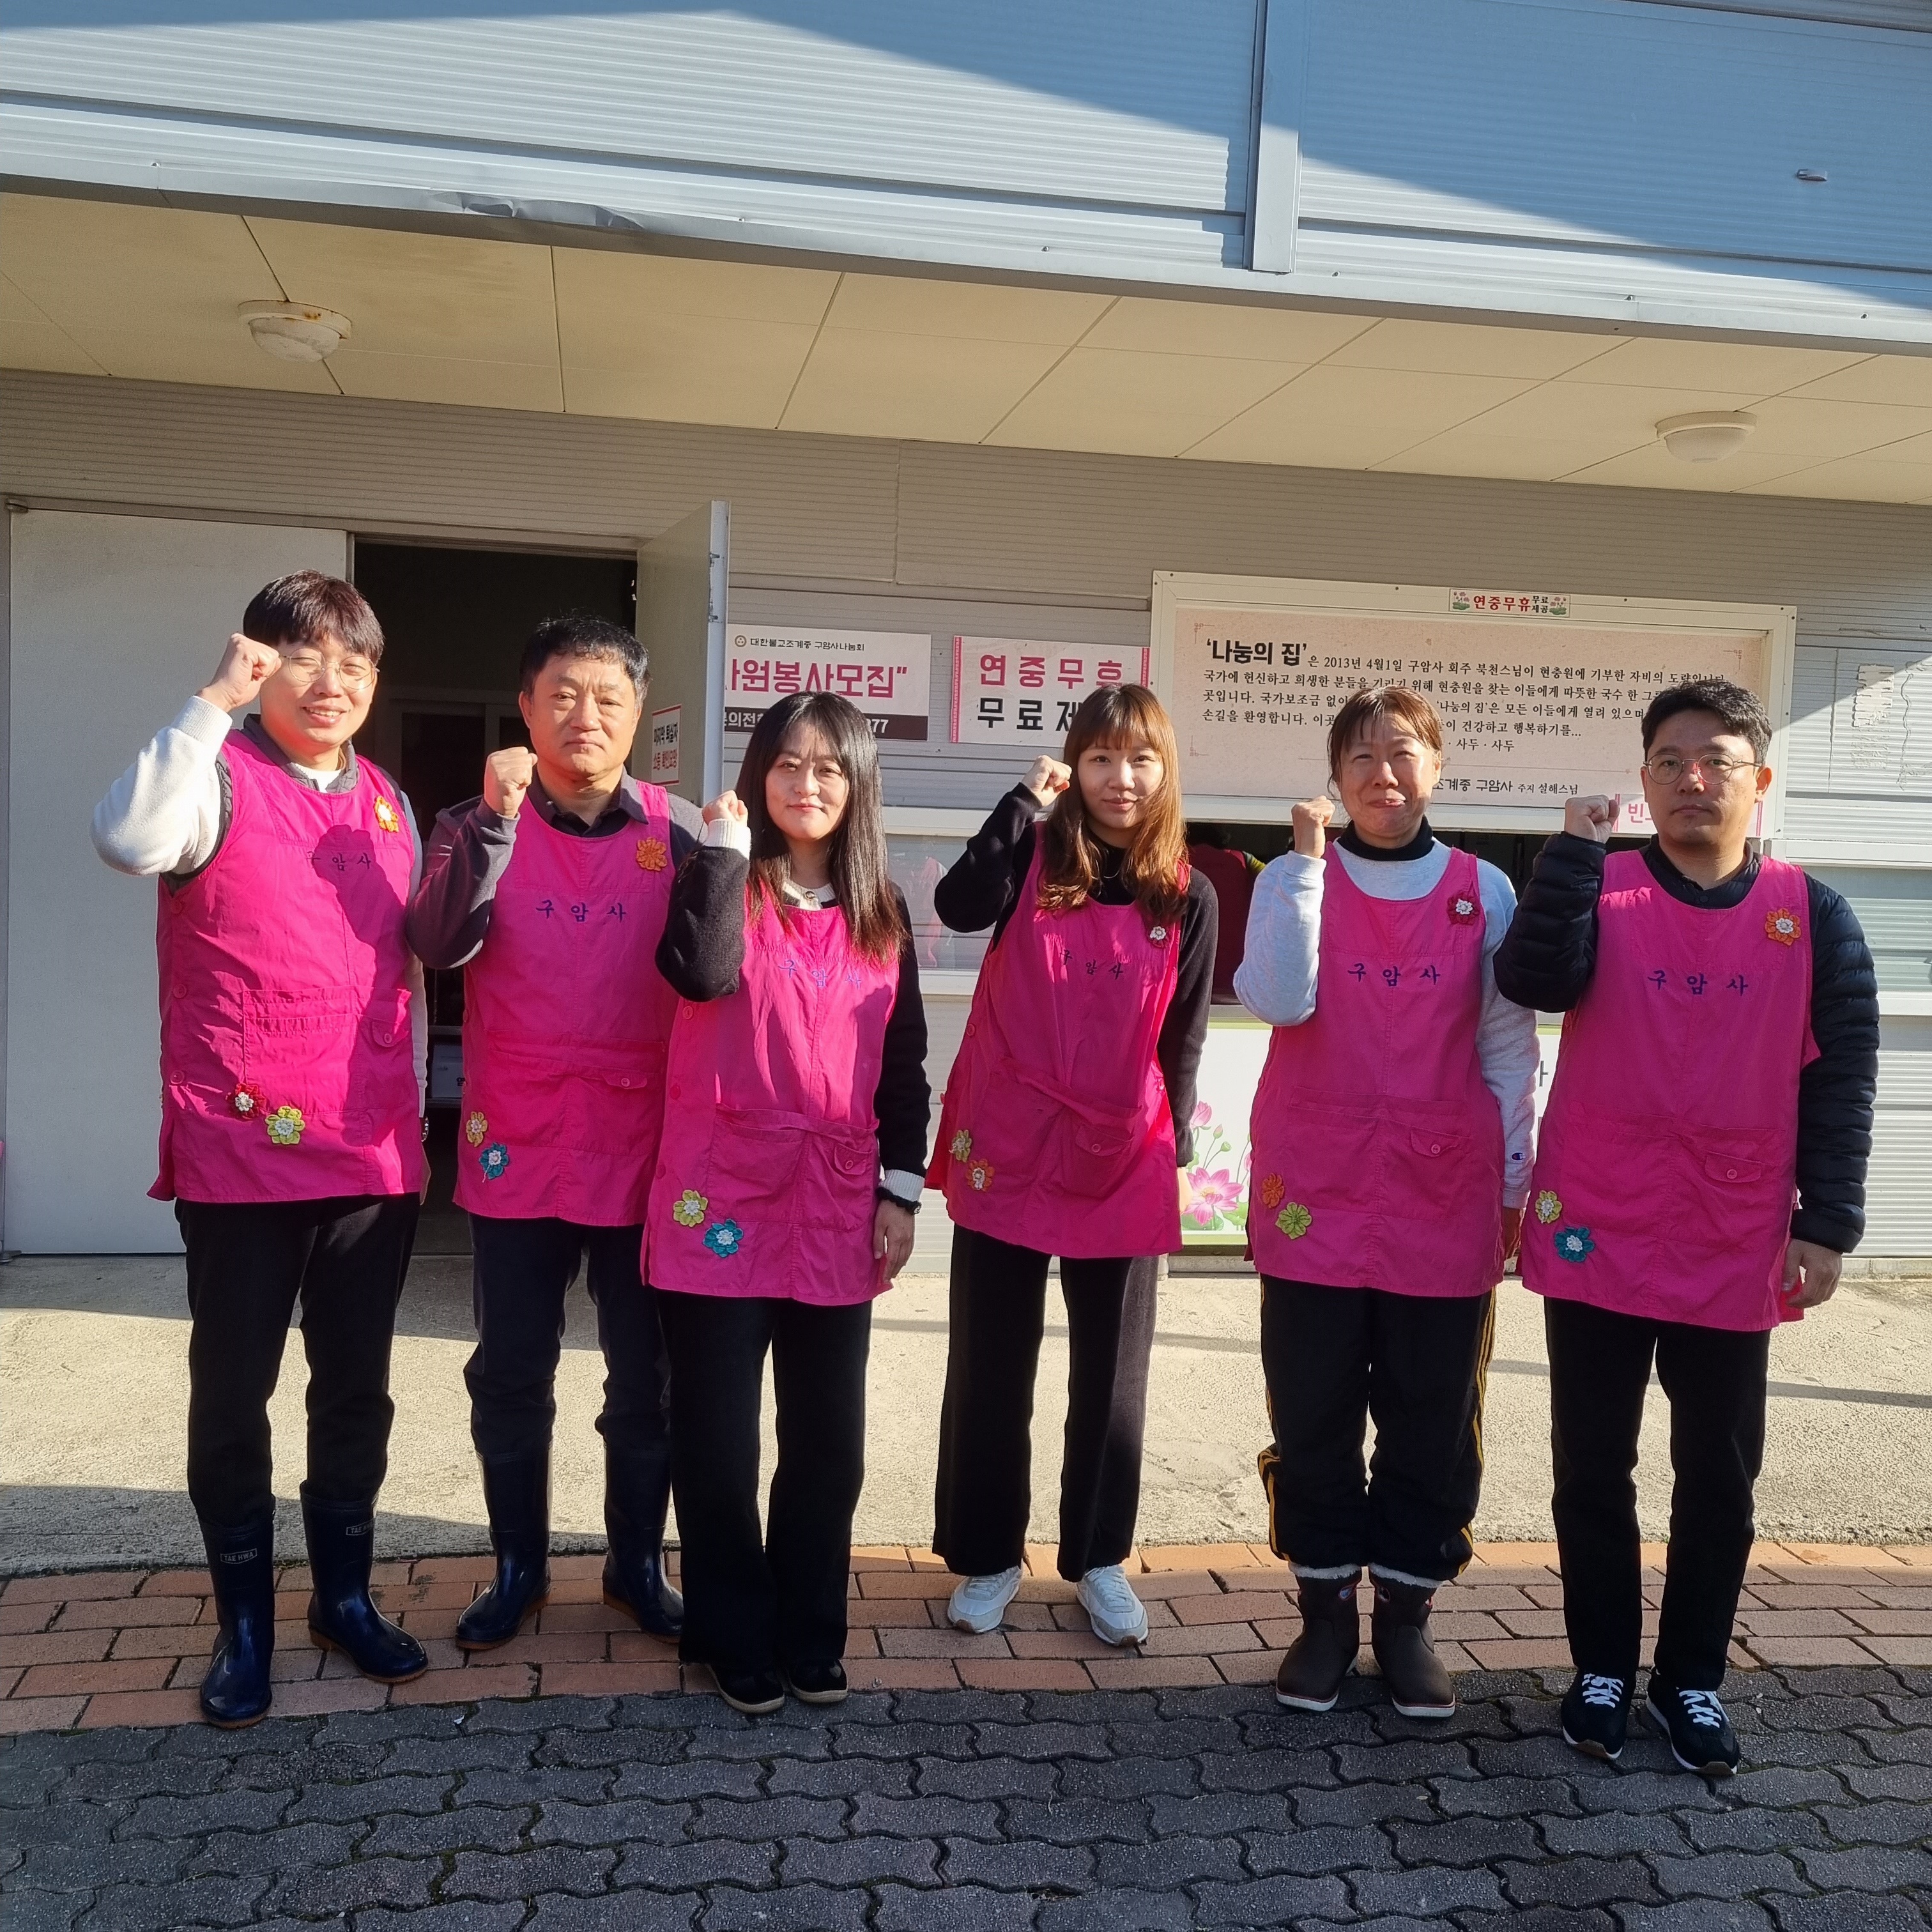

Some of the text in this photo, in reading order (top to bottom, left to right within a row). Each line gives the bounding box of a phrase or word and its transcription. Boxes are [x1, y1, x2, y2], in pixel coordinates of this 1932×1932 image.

[1473, 595, 1531, 612] 연중무휴
[1532, 595, 1549, 604] 무료
[750, 638, 811, 649] 대한불교조계종
[1324, 657, 1361, 670] 2013년
[1367, 658, 1402, 671] 4월1일
[1408, 660, 1444, 673] 구암사
[1448, 661, 1471, 675] 회주
[1476, 663, 1534, 677] 북천스님이
[1540, 666, 1585, 680] 현충원에
[1591, 668, 1625, 682] 기부한
[1629, 670, 1663, 684] 자비의
[1203, 670, 1238, 684] 국가에
[1244, 671, 1290, 685] 헌신하고
[1294, 673, 1330, 687] 희생한
[1334, 675, 1368, 689] 분들을
[1411, 679, 1433, 693] 위해
[1438, 680, 1483, 694] 현충원을
[1488, 683, 1510, 696] 찾는
[1514, 684, 1559, 698] 이들에게
[1564, 687, 1597, 700] 따뜻한
[1601, 688, 1623, 701] 국수
[1627, 689, 1638, 702] 한
[1202, 689, 1348, 707] 곳입니다. 국가보조금 없이
[1202, 709, 1239, 722] 손길을
[1243, 710, 1307, 725] 환영합니다.
[1505, 703, 1528, 716] 모든
[1533, 704, 1578, 718] 이들에게
[1584, 706, 1606, 719] 열려
[1611, 707, 1644, 720] 있으며
[1462, 720, 1508, 733] 건강하고
[1456, 739, 1514, 753] 사두 사두
[1476, 779, 1513, 792] 구암사
[1518, 784, 1534, 793] 주지
[1538, 783, 1578, 795] 설해스님
[1628, 802, 1653, 824] 빈
[238, 1551, 254, 1561] HWA
